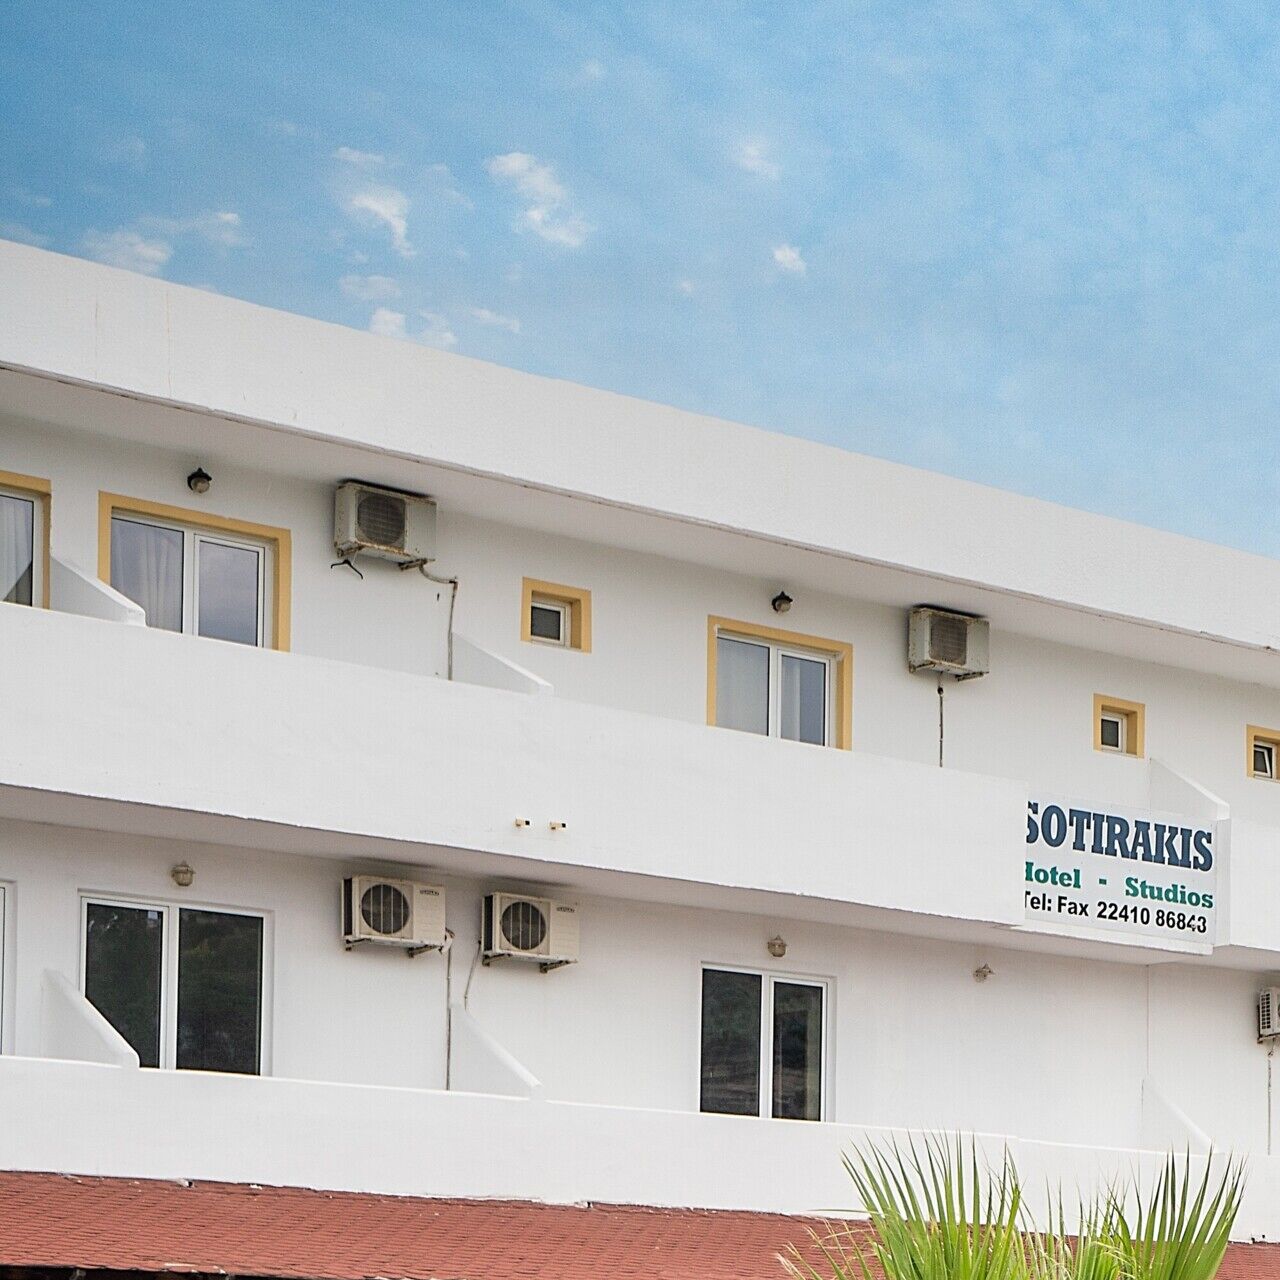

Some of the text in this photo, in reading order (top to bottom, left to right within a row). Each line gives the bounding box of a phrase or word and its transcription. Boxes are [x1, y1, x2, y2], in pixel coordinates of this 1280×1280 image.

[1026, 801, 1212, 872] SOTIRAKIS
[1125, 877, 1213, 908] Studios
[1057, 895, 1089, 917] Fax
[1097, 901, 1150, 925] 22410
[1155, 909, 1207, 934] 86843
